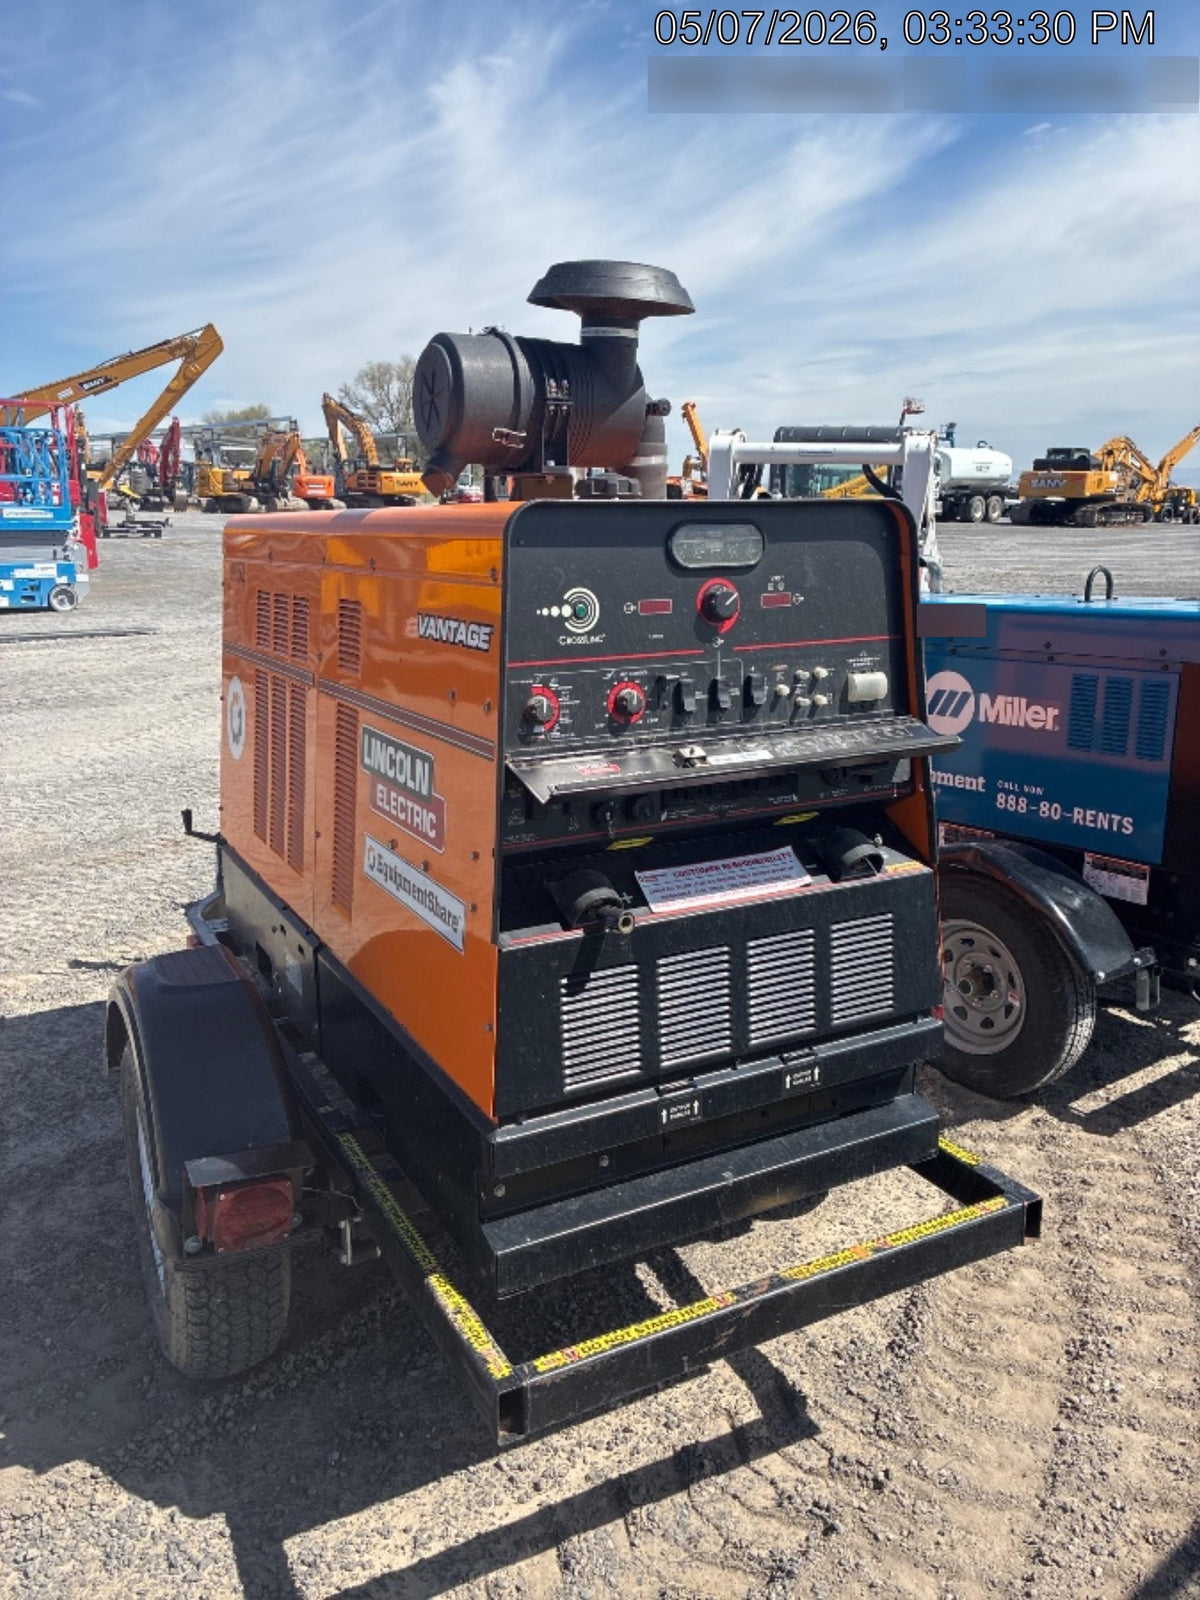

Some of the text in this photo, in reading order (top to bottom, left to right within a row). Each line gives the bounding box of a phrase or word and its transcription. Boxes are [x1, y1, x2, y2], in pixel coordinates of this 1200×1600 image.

[417, 612, 492, 652] VANTAGE
[979, 692, 1059, 732] Miller
[363, 734, 430, 797] LINCOLN
[997, 780, 1019, 792] CALL
[376, 783, 437, 838] ELECTRIC
[996, 792, 1134, 835] 888-80-RENTS
[377, 853, 460, 934] EquipmentShare
[580, 1301, 714, 1354] DO NOT STAND HERE
